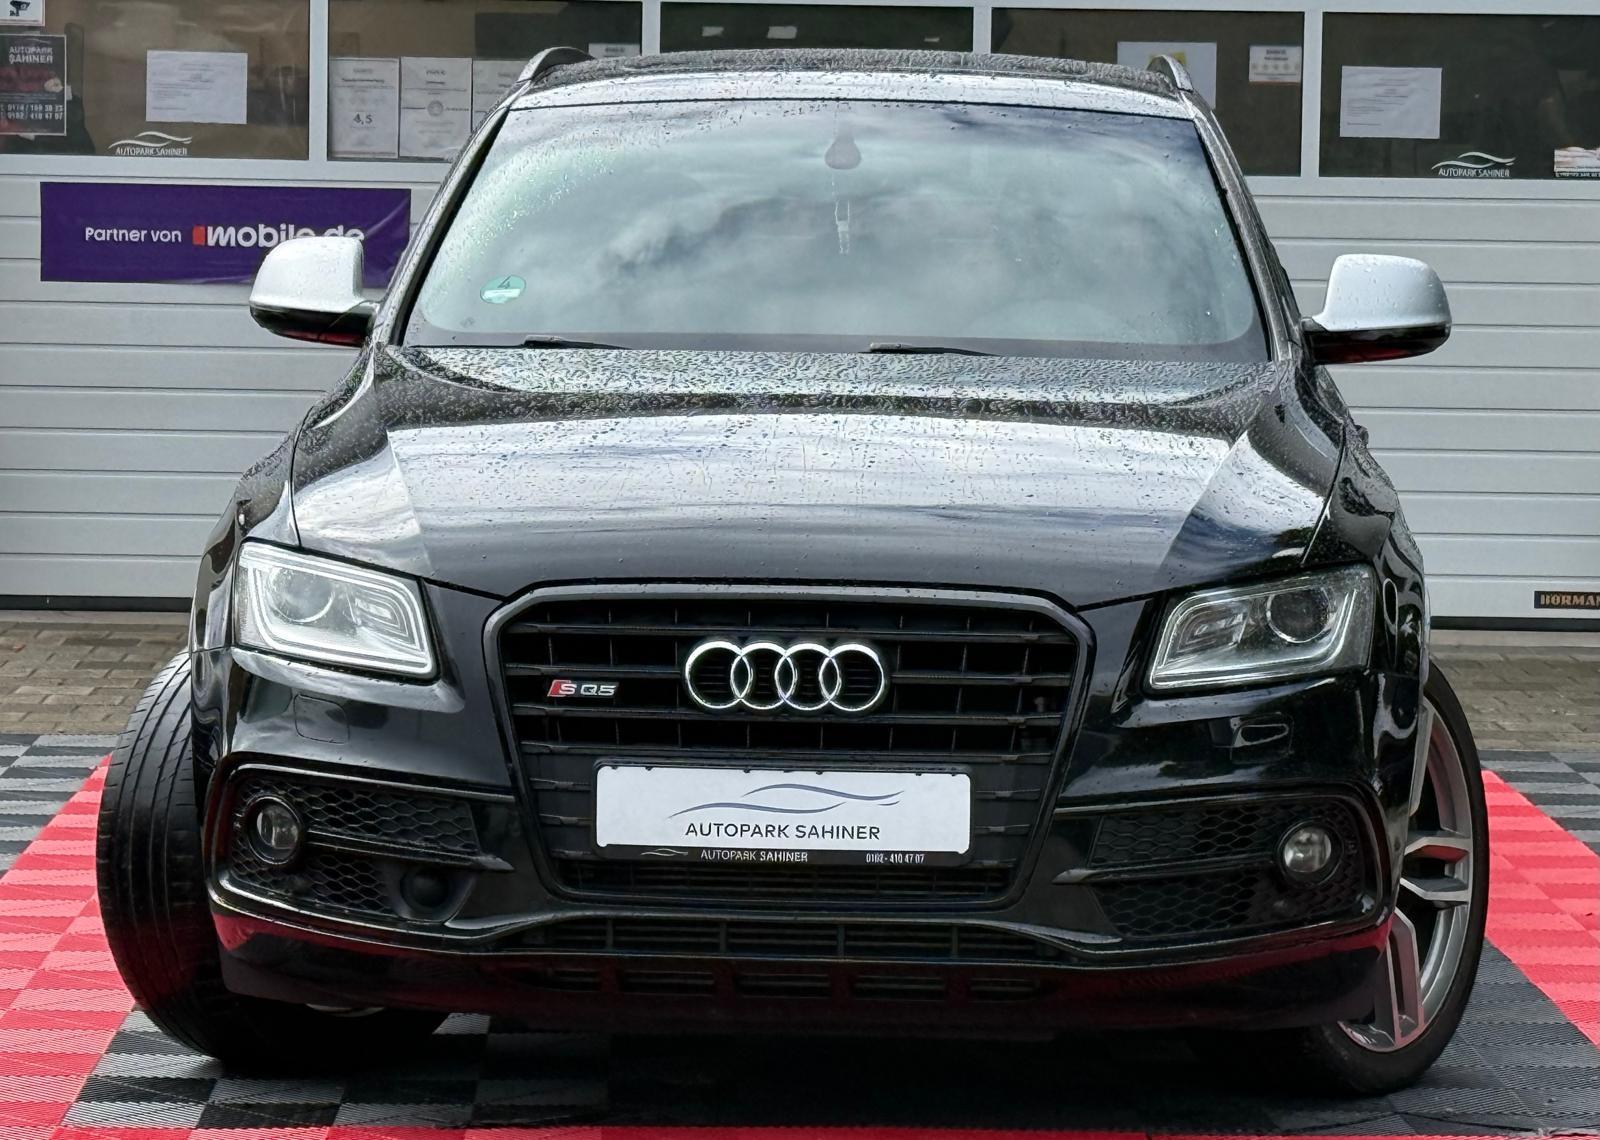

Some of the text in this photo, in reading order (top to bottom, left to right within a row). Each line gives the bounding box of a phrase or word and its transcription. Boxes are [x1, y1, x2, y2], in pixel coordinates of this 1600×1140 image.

[115, 147, 154, 155] AUTOPARK
[1438, 168, 1510, 177] AUTOPARK SAHINER
[85, 223, 364, 247] Partner von mobil
[685, 822, 880, 840] AUTOPARK SAHINER
[701, 849, 808, 862] AUTOPARK SAHINER
